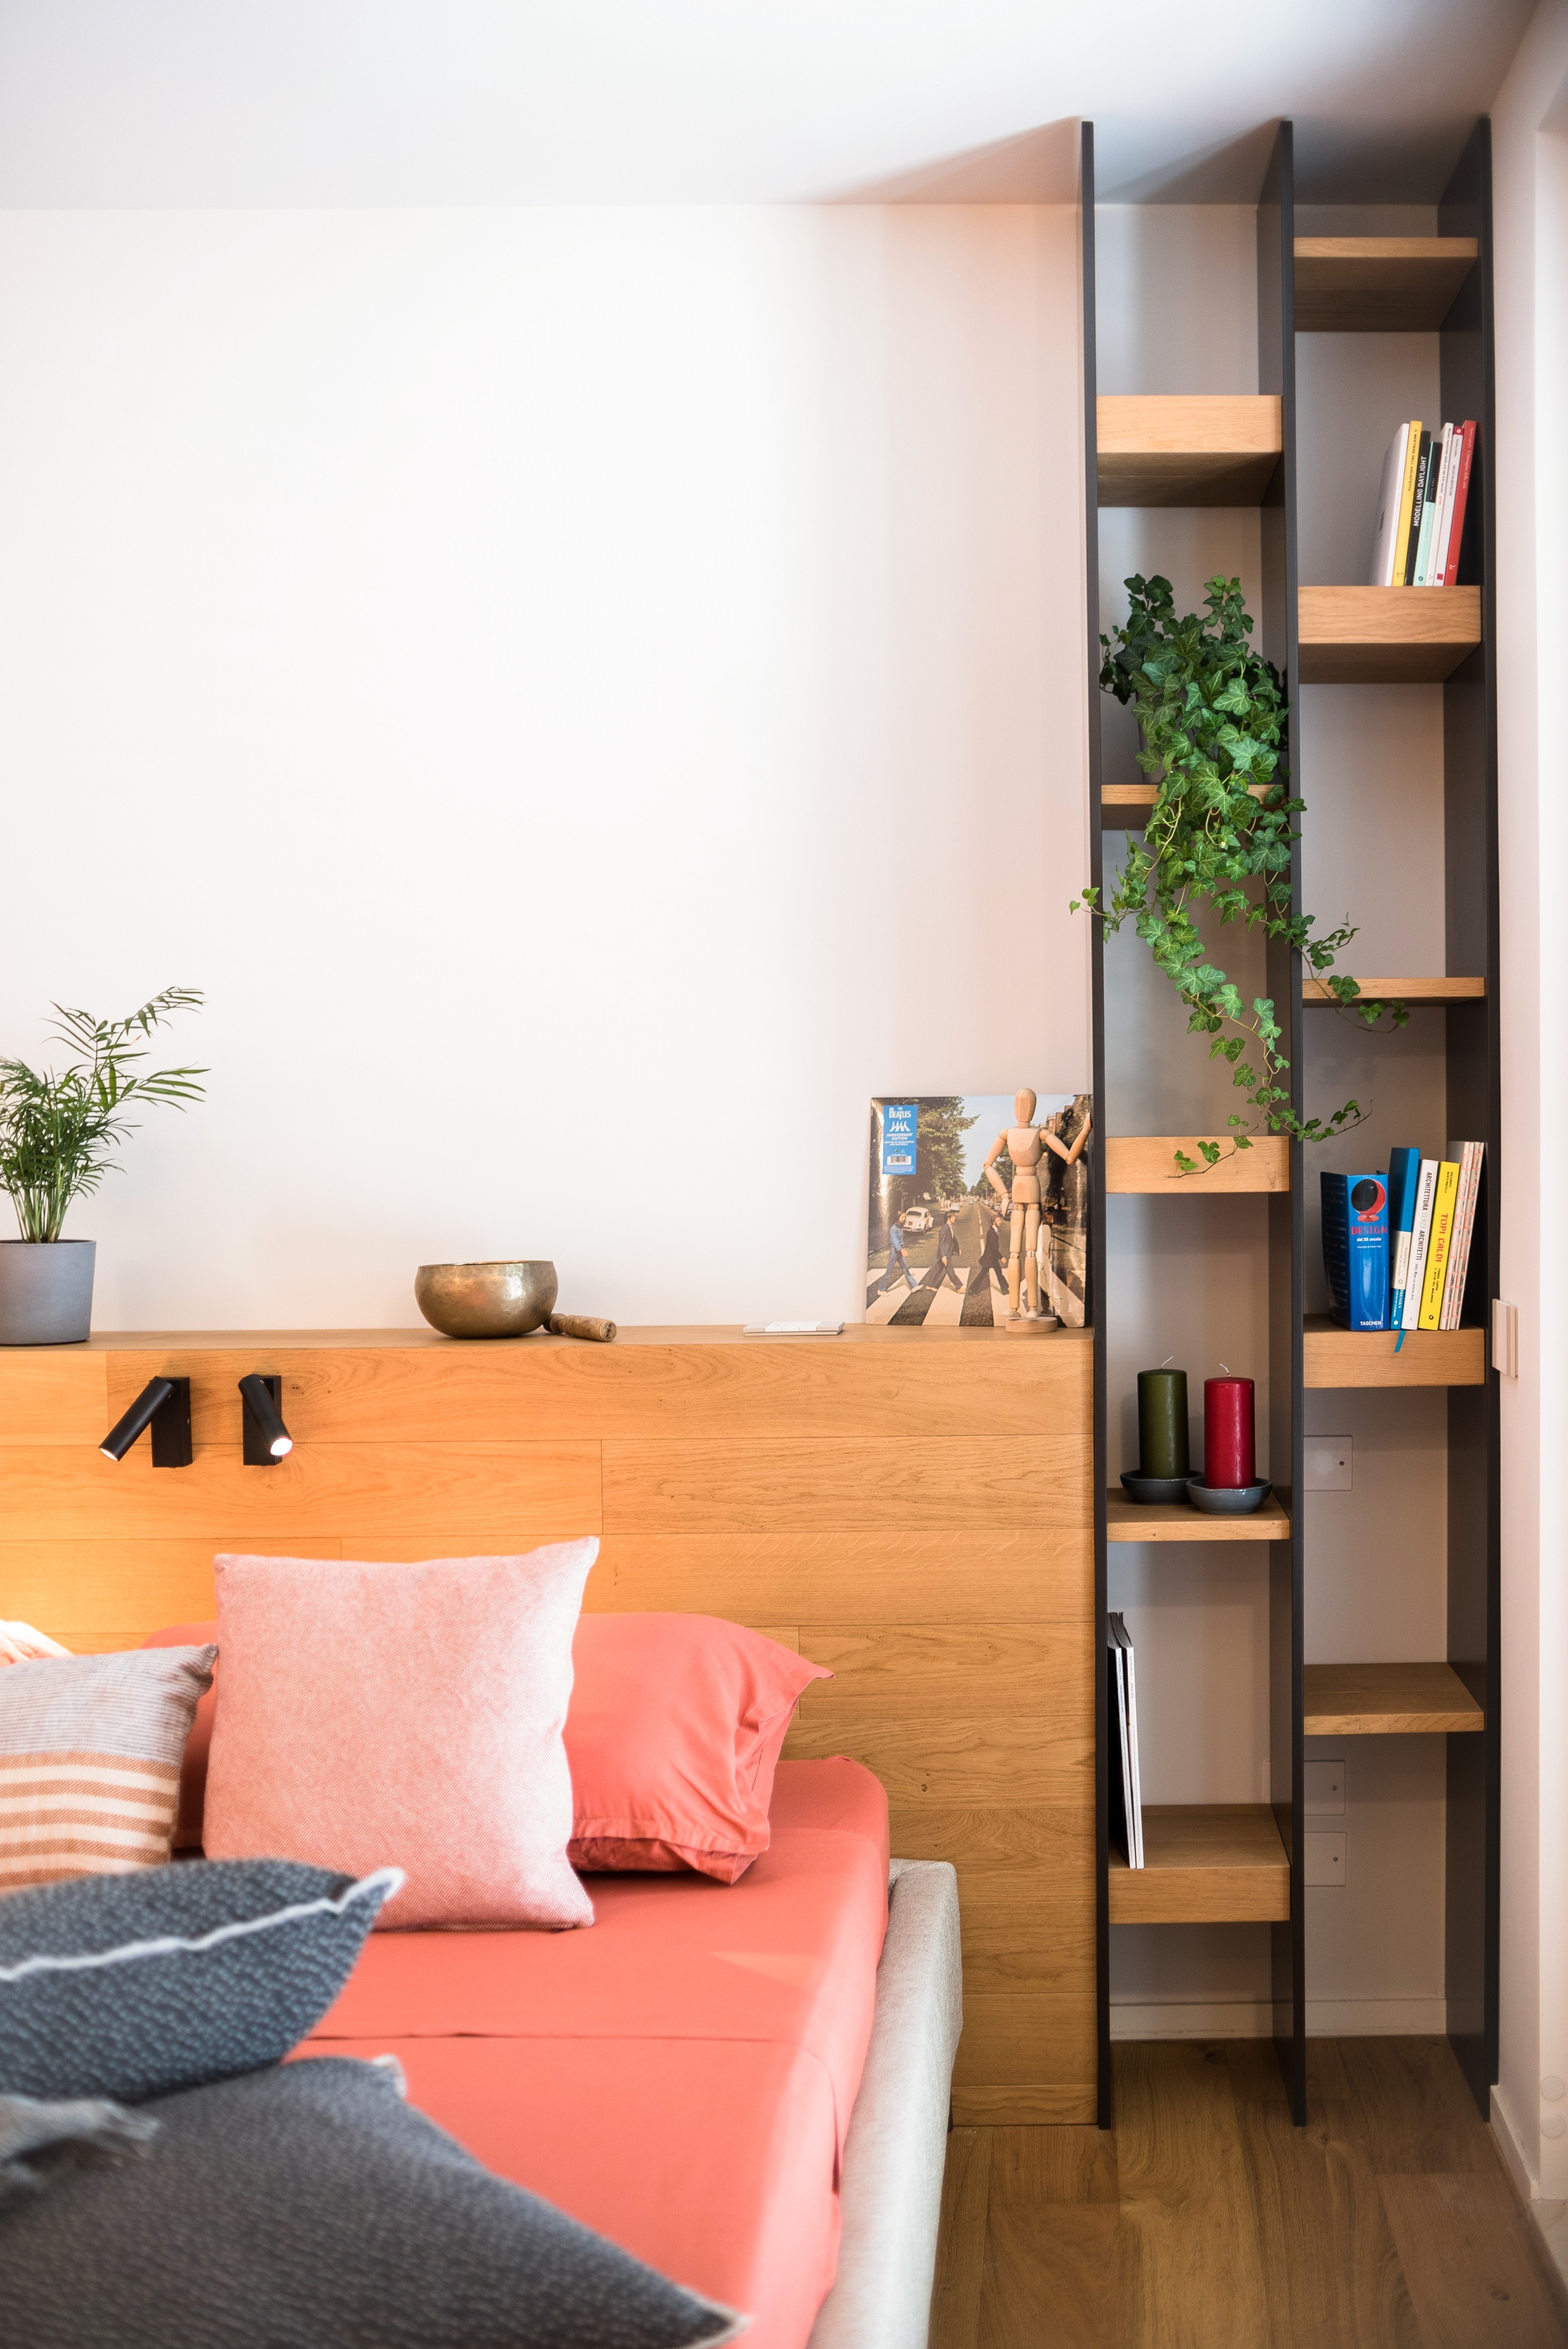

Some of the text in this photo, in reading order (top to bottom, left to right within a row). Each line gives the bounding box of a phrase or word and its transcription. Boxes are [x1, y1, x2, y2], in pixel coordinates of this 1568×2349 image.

[1413, 456, 1428, 526] MODELLING DAYLIGHT
[889, 1107, 911, 1120] BEATLES
[1421, 1171, 1433, 1211] ARCHITETTURA
[1351, 1226, 1387, 1235] DESIGN
[1416, 1229, 1426, 1260] ARCHITETTI
[1435, 1213, 1448, 1263] TOPI CALDI
